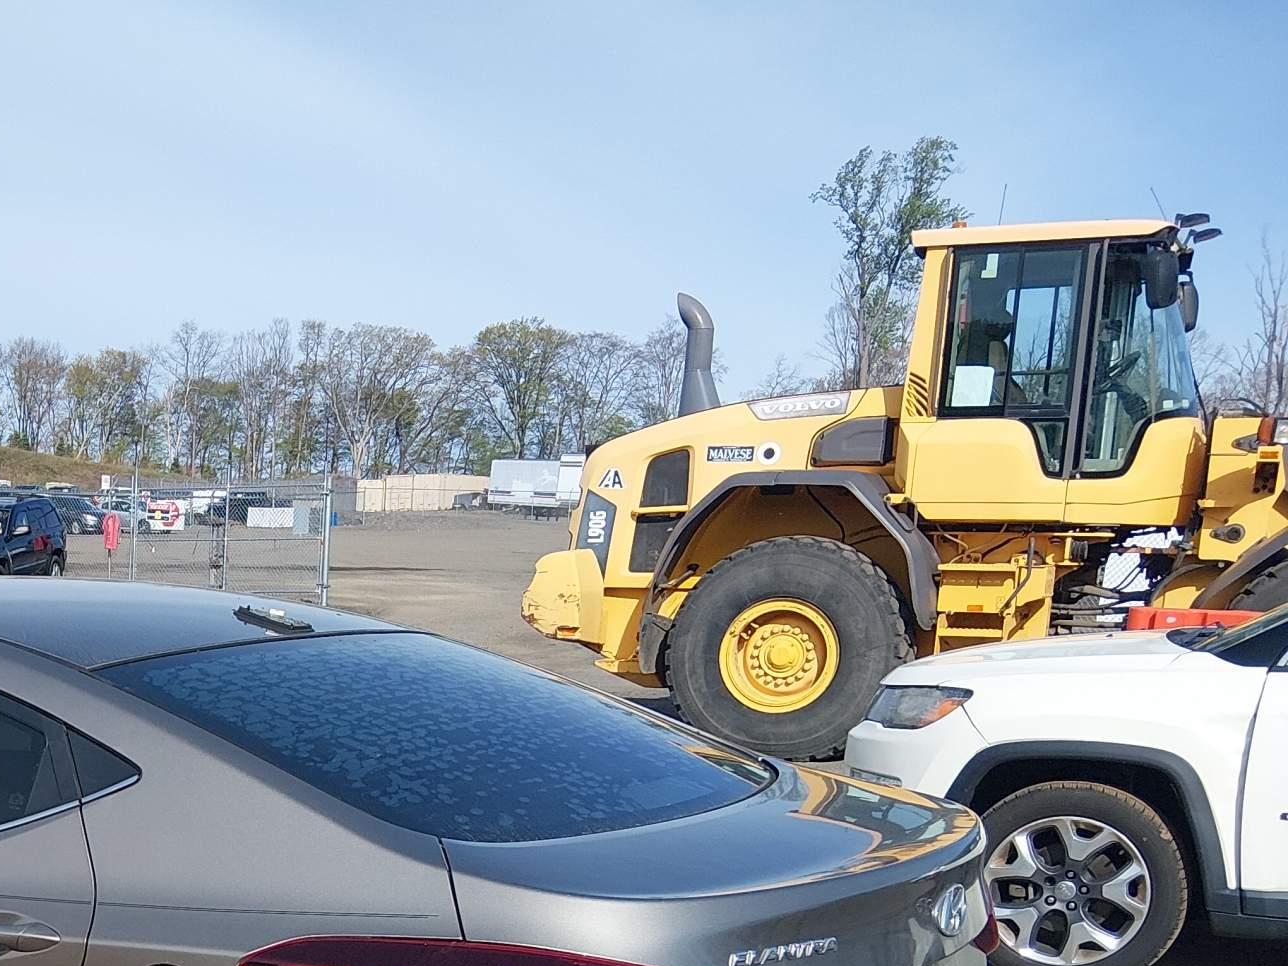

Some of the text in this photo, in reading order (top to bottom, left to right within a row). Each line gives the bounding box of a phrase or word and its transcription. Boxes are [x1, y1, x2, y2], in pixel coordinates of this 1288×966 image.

[759, 399, 841, 414] VOLVO
[708, 447, 754, 460] MALVESE
[587, 510, 607, 544] L90G
